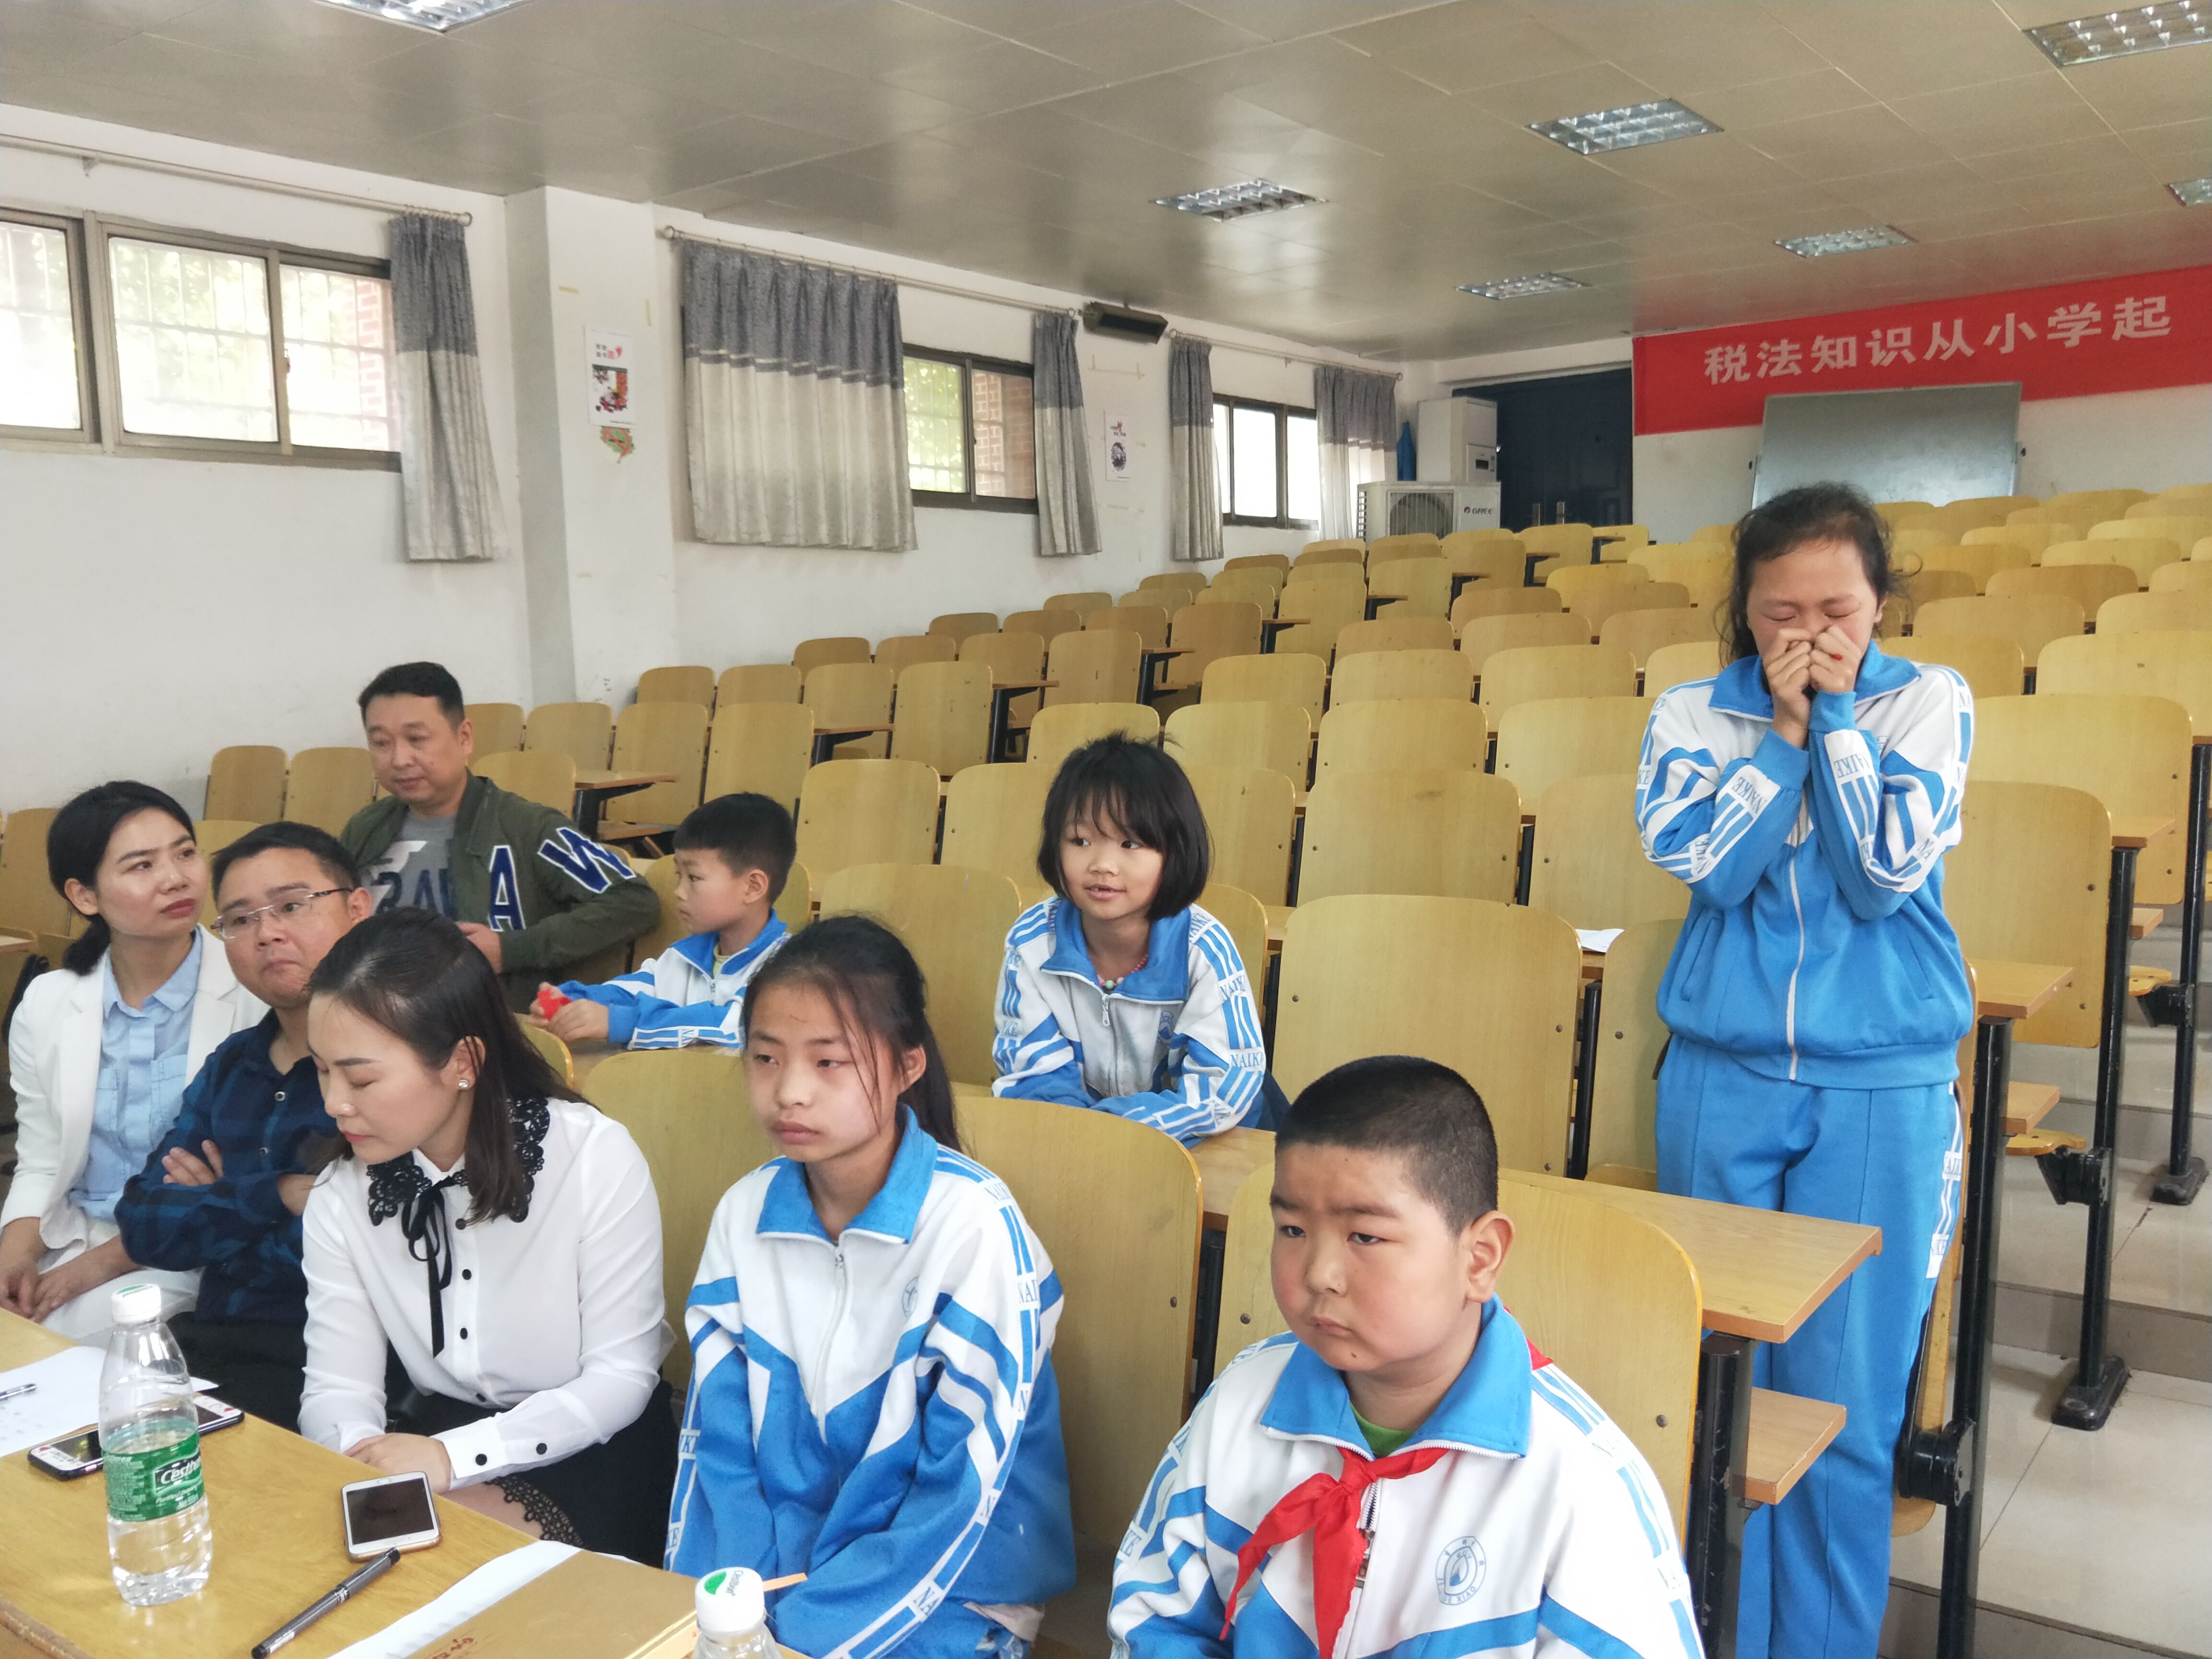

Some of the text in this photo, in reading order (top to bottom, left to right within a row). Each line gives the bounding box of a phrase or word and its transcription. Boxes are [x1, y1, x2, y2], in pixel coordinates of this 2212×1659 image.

[1704, 296, 2173, 385] 税法知识从小学起
[1731, 776, 1767, 814] NAIKE
[488, 845, 527, 932] A
